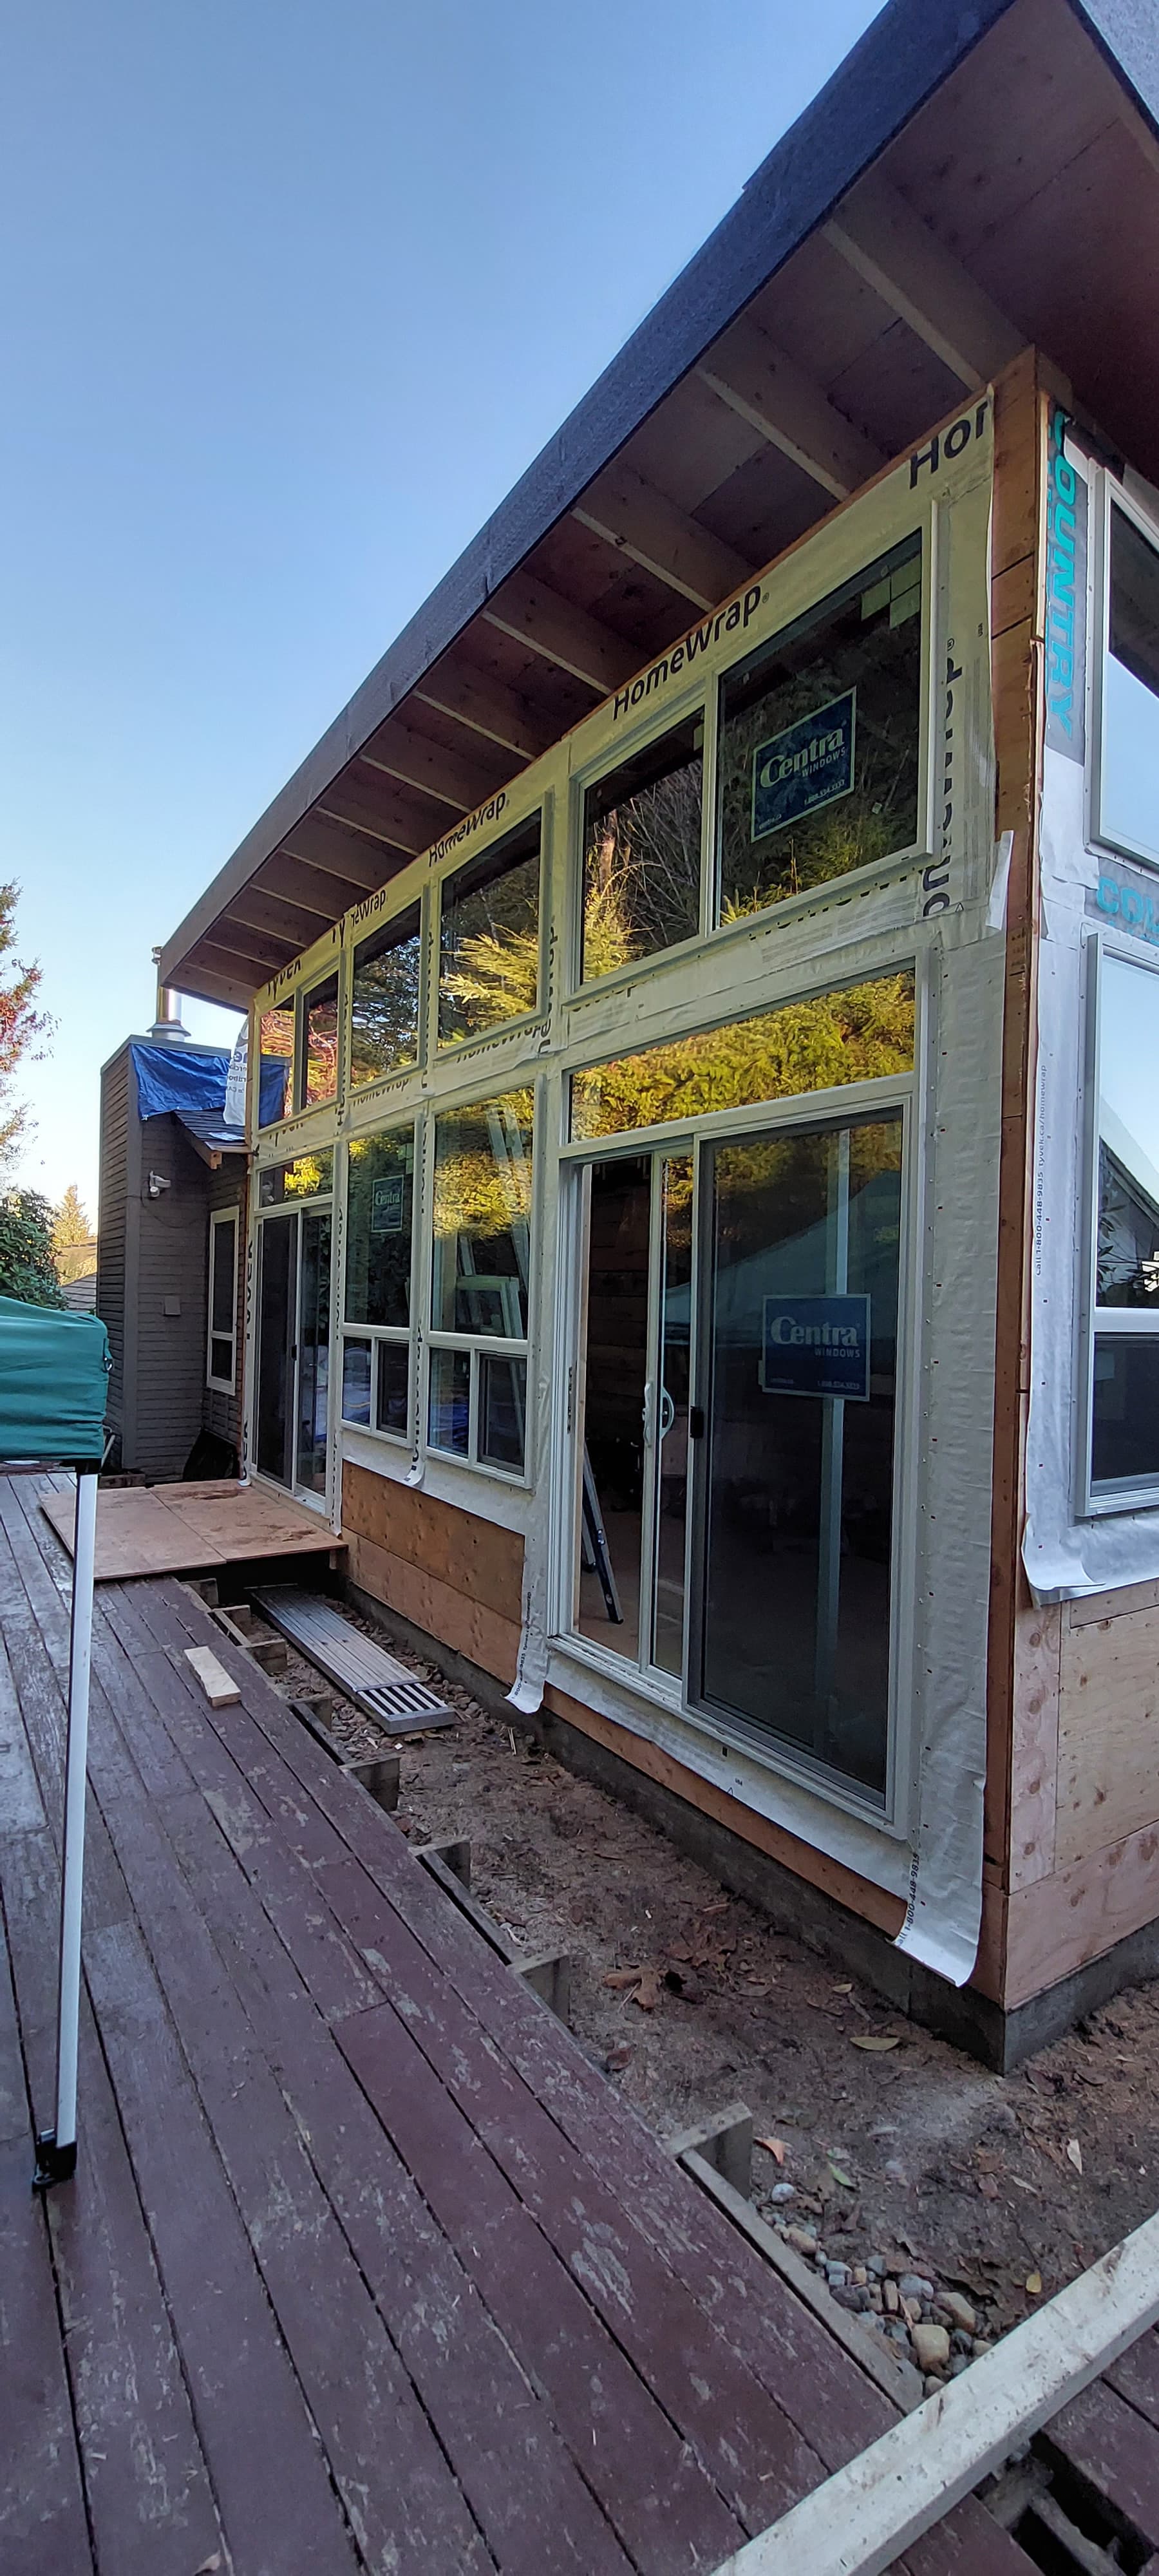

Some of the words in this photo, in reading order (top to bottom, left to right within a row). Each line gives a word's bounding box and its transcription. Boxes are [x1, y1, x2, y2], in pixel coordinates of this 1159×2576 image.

[760, 728, 845, 788] Centra
[802, 746, 846, 777] WINDOWS
[1038, 1065, 1048, 1167] tyvek.ca/homewrap
[1035, 1171, 1044, 1256] 1-800-448-9835
[770, 1316, 859, 1347] Centra
[814, 1348, 860, 1358] WINDOWS
